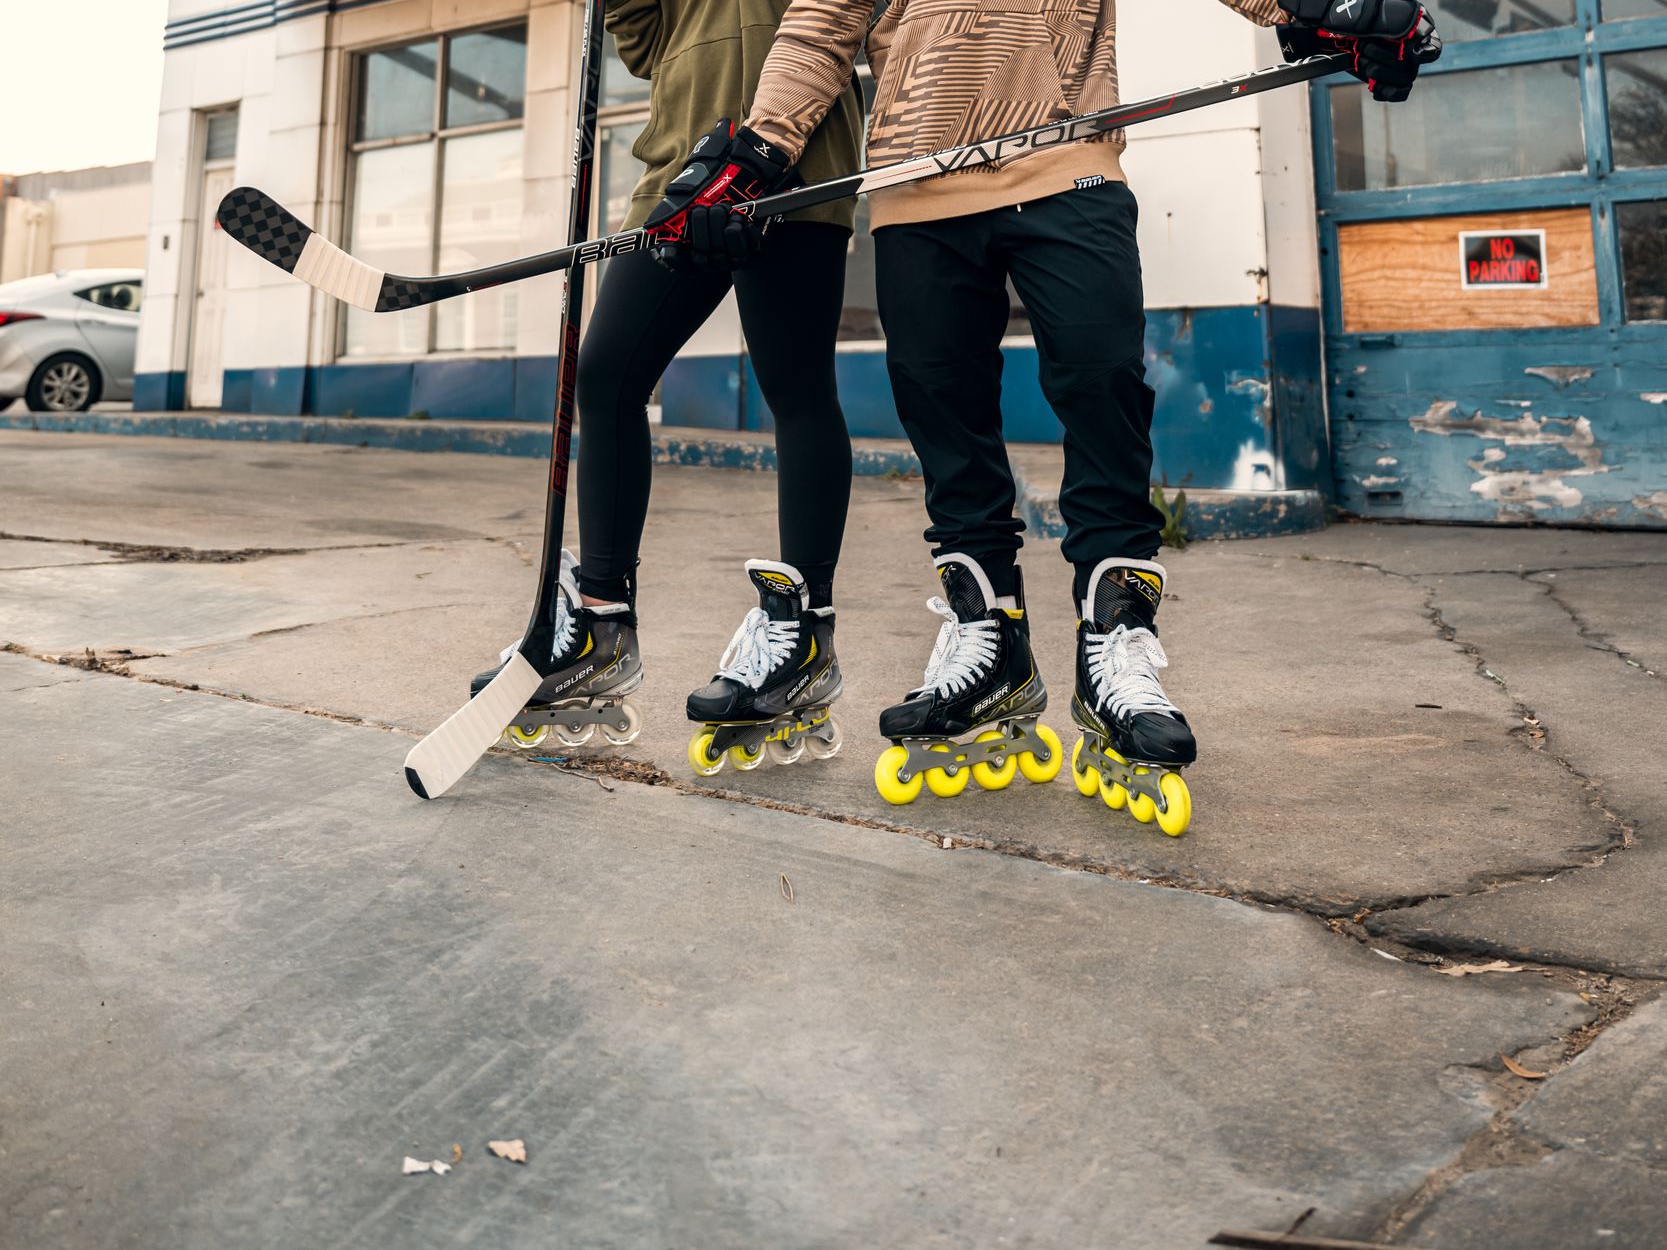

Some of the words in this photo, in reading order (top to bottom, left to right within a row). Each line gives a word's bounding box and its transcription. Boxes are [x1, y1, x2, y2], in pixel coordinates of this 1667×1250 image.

[1230, 83, 1248, 95] 3X
[933, 119, 1101, 174] VAPOR
[1490, 237, 1515, 259] NO
[1468, 259, 1539, 282] PARKING
[555, 664, 594, 694] BAUER
[786, 674, 810, 701] BAUER
[973, 685, 1010, 715] BAUER
